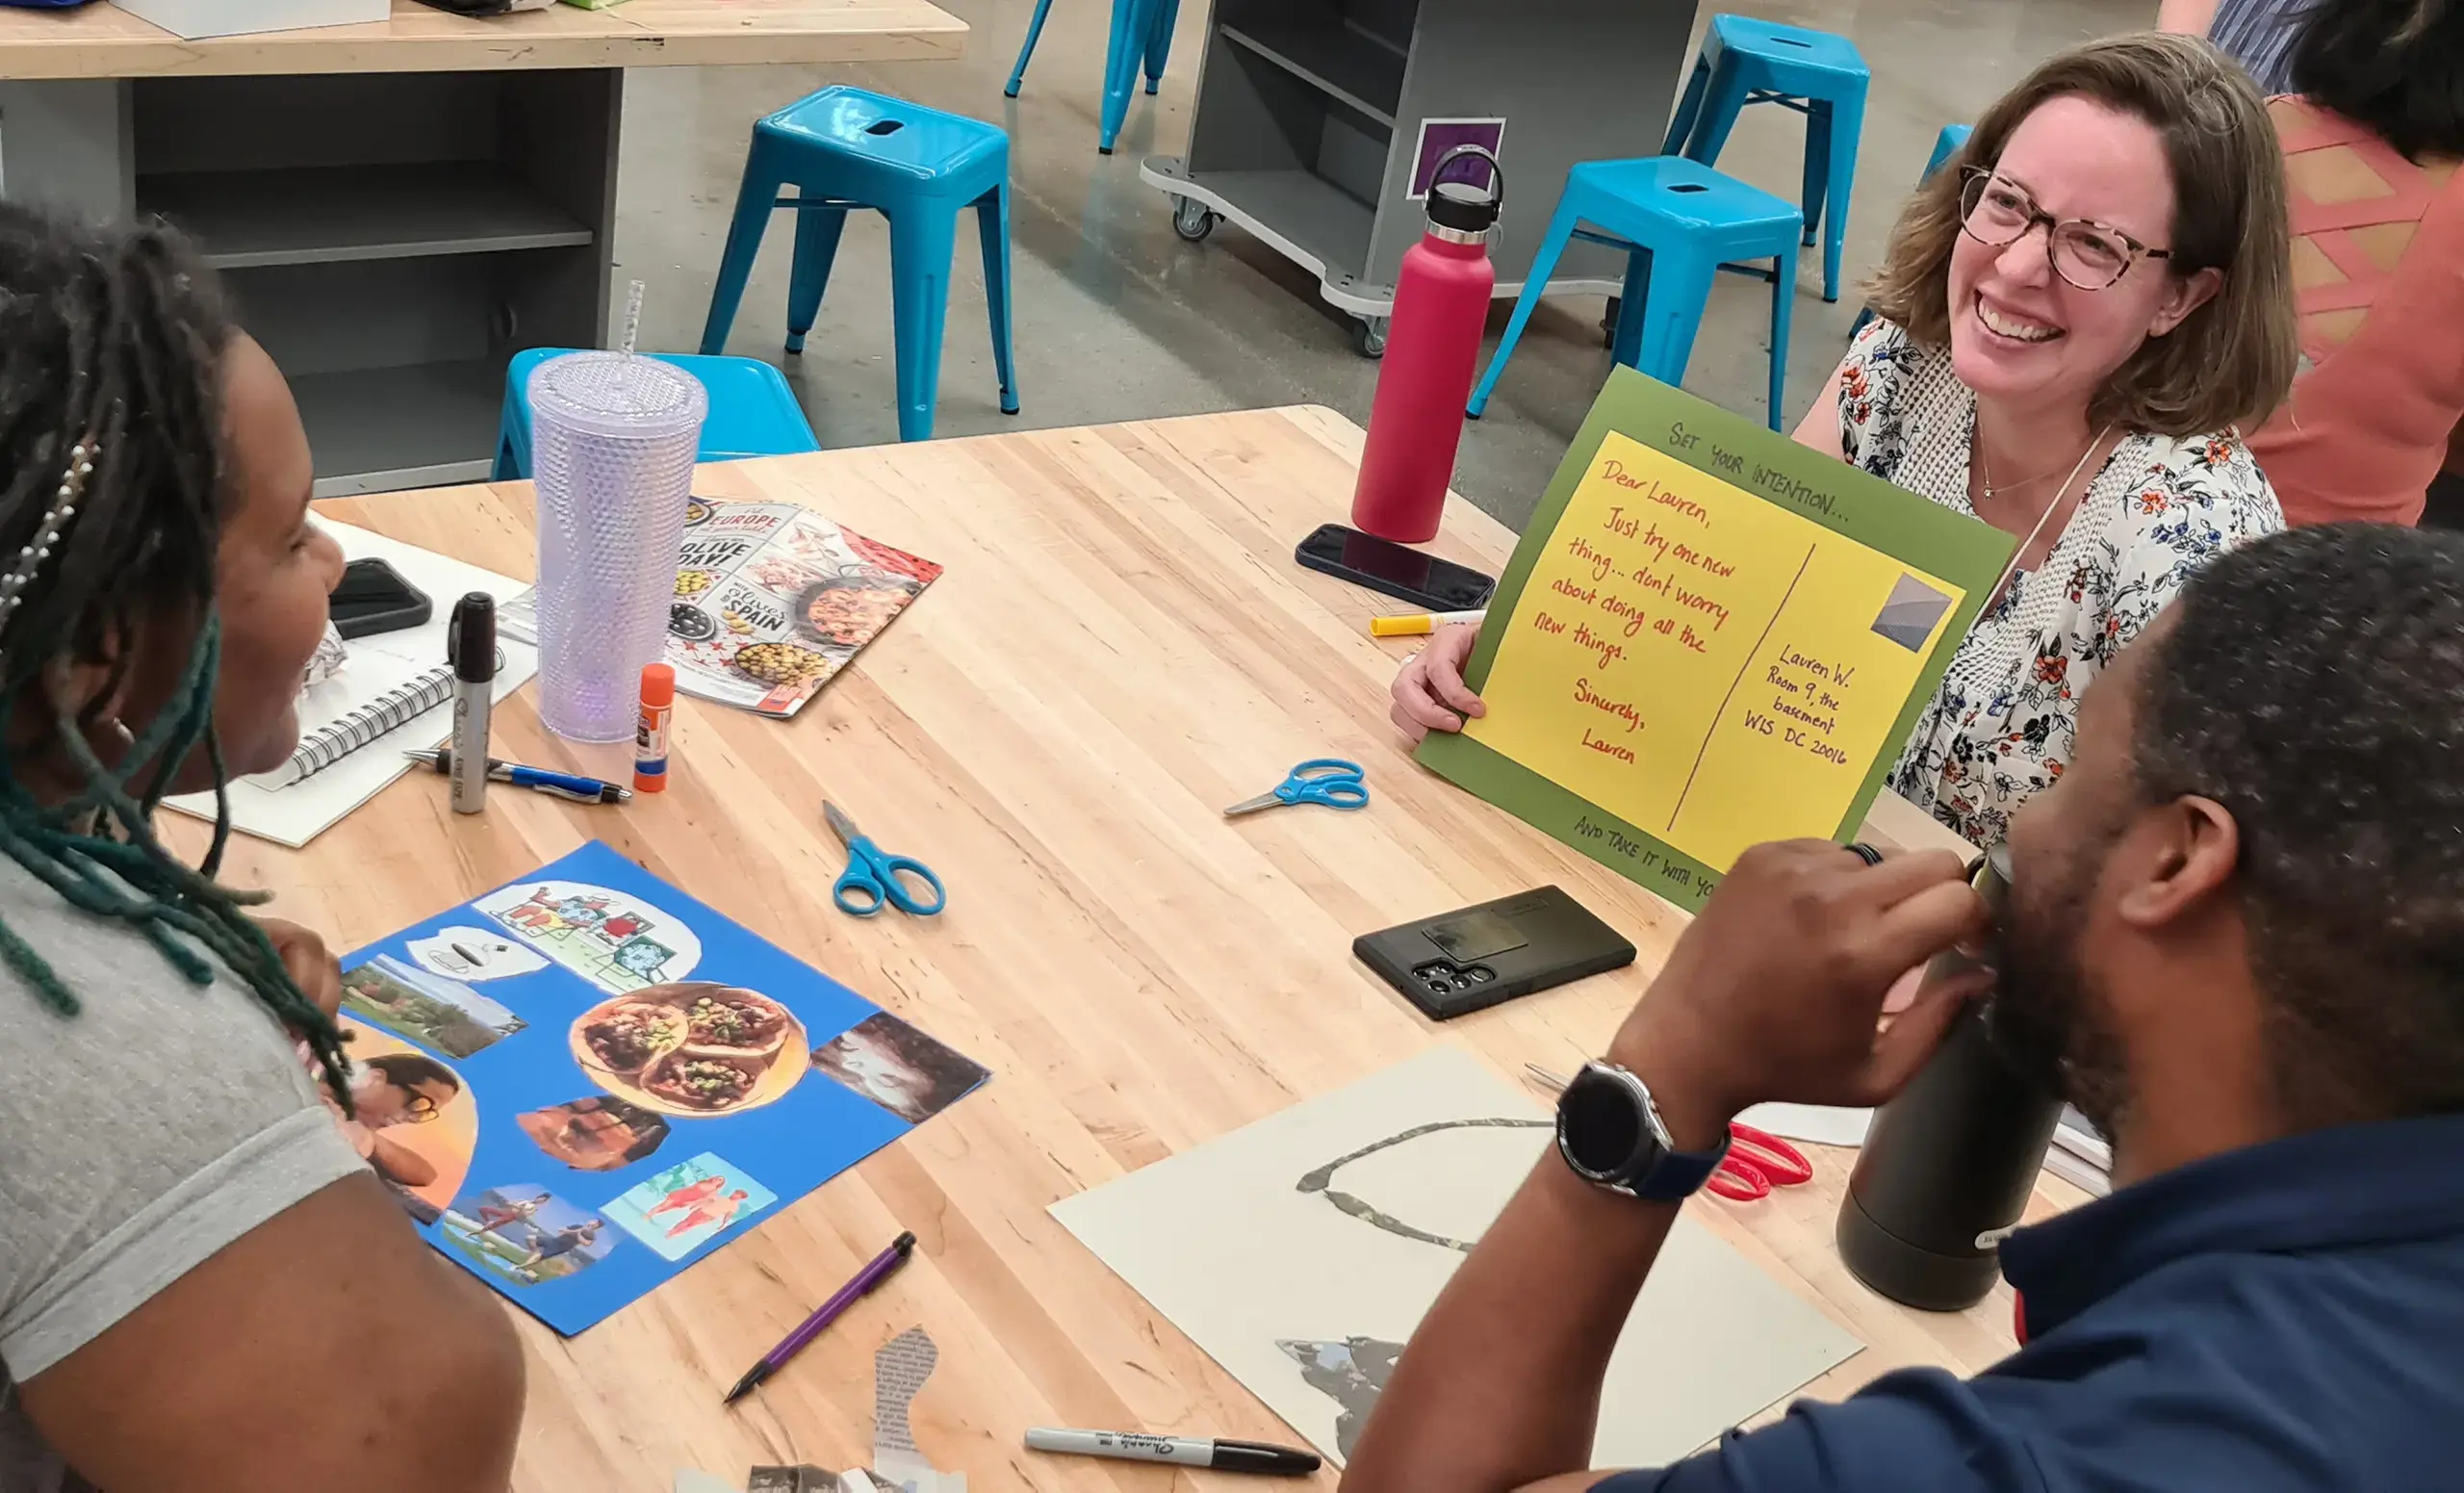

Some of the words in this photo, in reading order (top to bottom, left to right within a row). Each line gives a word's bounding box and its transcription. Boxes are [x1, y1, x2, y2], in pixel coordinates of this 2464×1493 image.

[1711, 445, 1744, 475] YOUR
[1601, 460, 1647, 490] Dear
[1647, 481, 1710, 528] Lauren,
[708, 515, 782, 528] EUROPE
[1604, 506, 1639, 539] Just
[1643, 523, 1670, 562] try
[1673, 543, 1699, 566] one
[1702, 556, 1735, 578] new
[678, 553, 732, 567] DAY!
[680, 542, 752, 556] OLIVE
[728, 588, 788, 619] Olives
[1569, 536, 1625, 581] thing...
[1632, 566, 1675, 597] dont
[1676, 586, 1730, 631] worry
[725, 600, 785, 631] SPAIN
[1552, 578, 1597, 605] about
[1601, 595, 1646, 637] doing
[1653, 619, 1676, 634] all
[1679, 625, 1707, 654] the
[1534, 611, 1566, 634] new
[1574, 622, 1627, 670] things.
[1780, 644, 1829, 679] Lauren
[1834, 663, 1855, 687] W.
[1766, 665, 1798, 692] Room
[1819, 692, 1839, 710] the
[1773, 695, 1835, 734] basement
[1581, 728, 1634, 764] Lauren
[1744, 709, 1775, 734] WIS
[1784, 728, 1806, 747] DC
[1810, 740, 1847, 764] 20016
[1575, 816, 1603, 838] AND
[1608, 830, 1639, 858] TAKE
[1642, 851, 1659, 866] IT
[1661, 860, 1691, 885] WITH
[1697, 876, 1714, 897] YO
